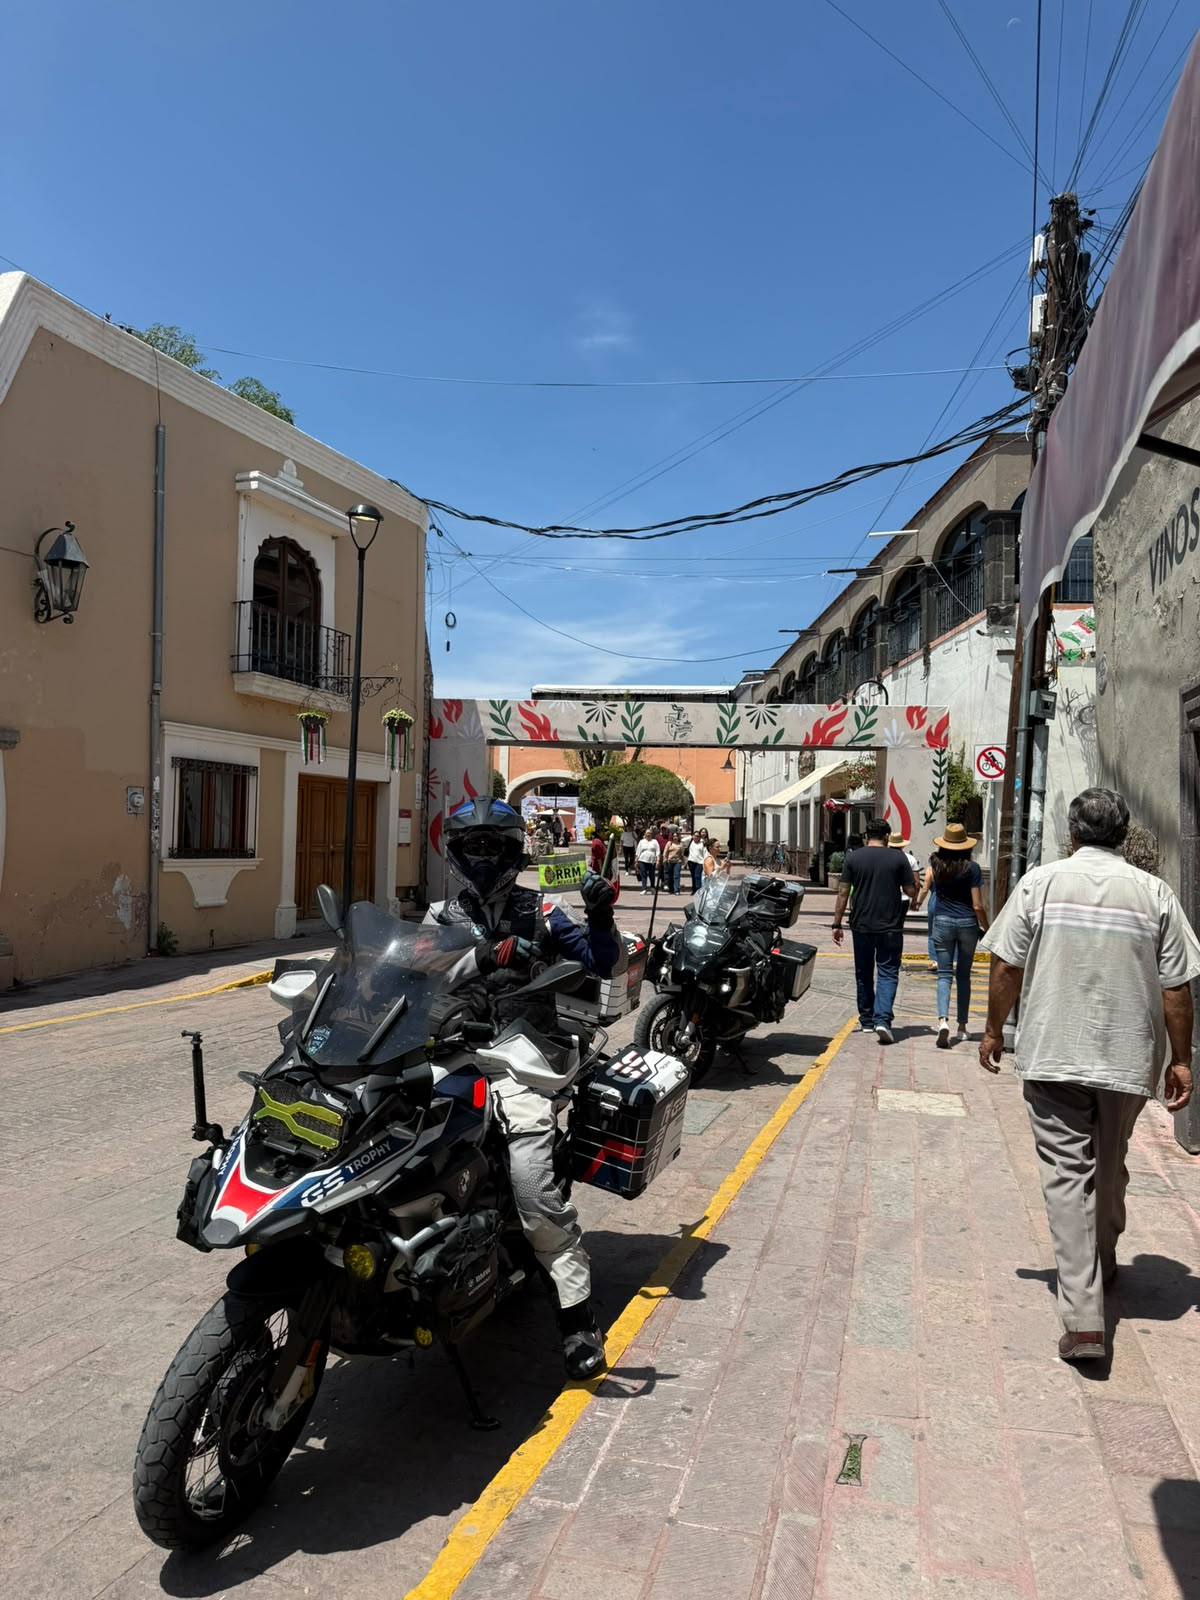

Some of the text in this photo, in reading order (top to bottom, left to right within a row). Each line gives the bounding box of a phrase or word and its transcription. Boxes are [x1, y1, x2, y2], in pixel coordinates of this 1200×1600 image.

[1149, 487, 1200, 596] VINOS
[556, 866, 582, 880] RRM
[301, 1140, 392, 1208] GS TROPHY
[475, 1265, 492, 1283] BMW
